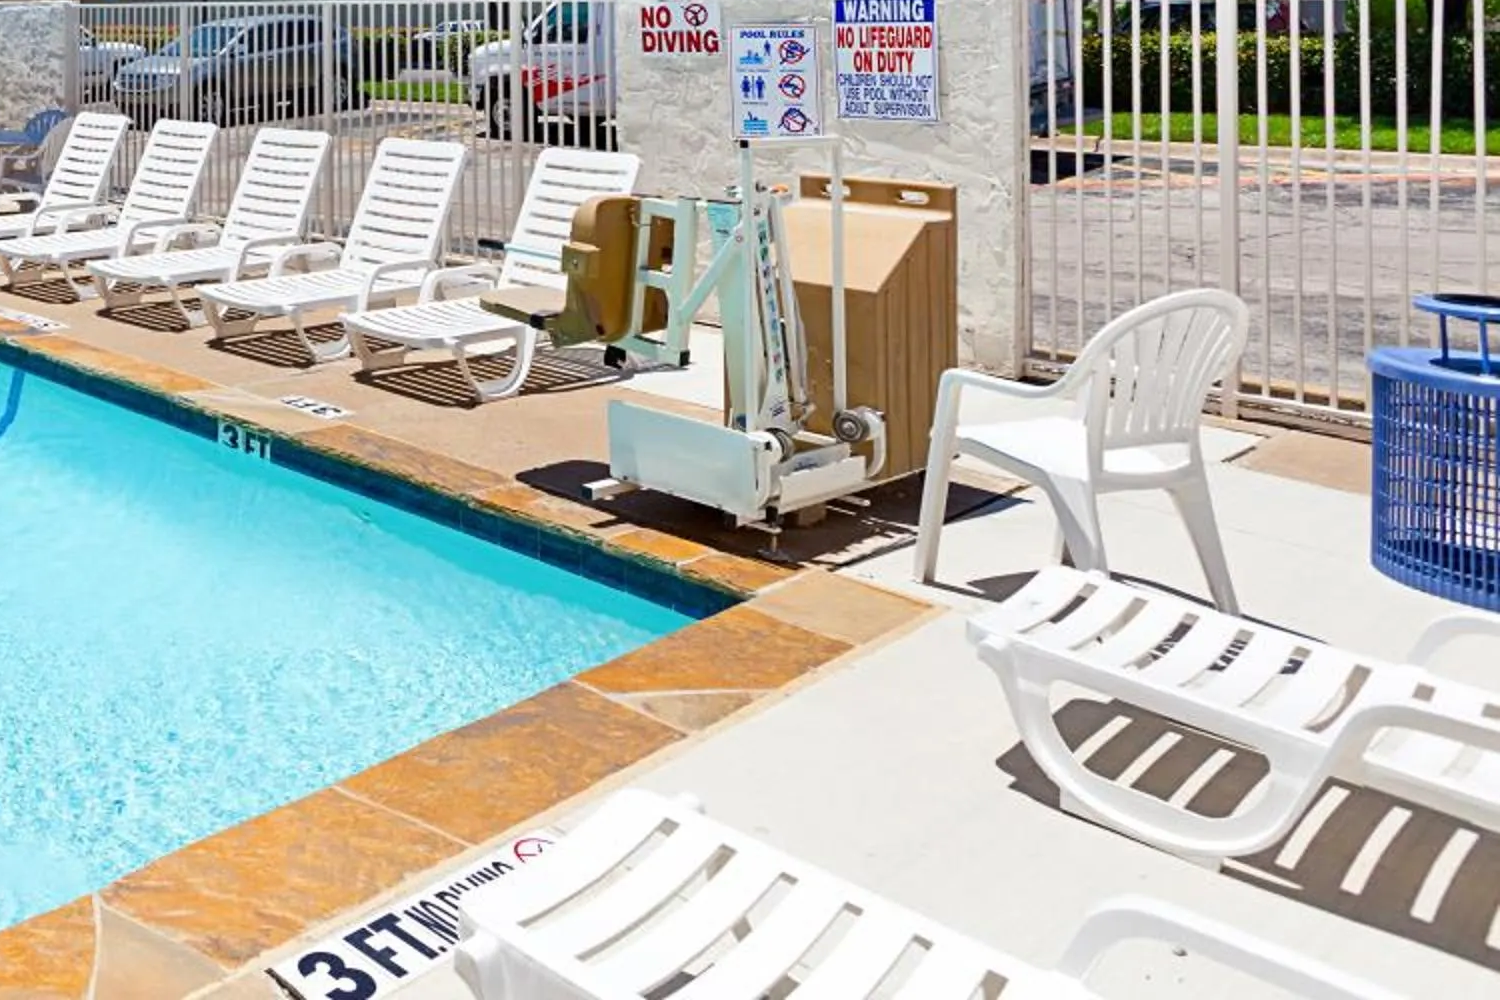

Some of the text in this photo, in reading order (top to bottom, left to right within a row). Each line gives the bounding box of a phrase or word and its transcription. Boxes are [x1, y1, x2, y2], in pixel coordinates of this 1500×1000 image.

[641, 6, 671, 28] NO
[642, 30, 719, 52] DIVING
[740, 30, 805, 38] POOL RULES
[837, 25, 932, 48] NO LIFEGUARD
[853, 50, 914, 73] ON DUTY
[839, 73, 933, 88] CHILDREN SHOULD NOT
[844, 87, 929, 102] USE POOL WITHOUT
[844, 101, 931, 117] ADULT SUPERVISION
[222, 424, 269, 459] 3 FT
[297, 951, 377, 1000] 3
